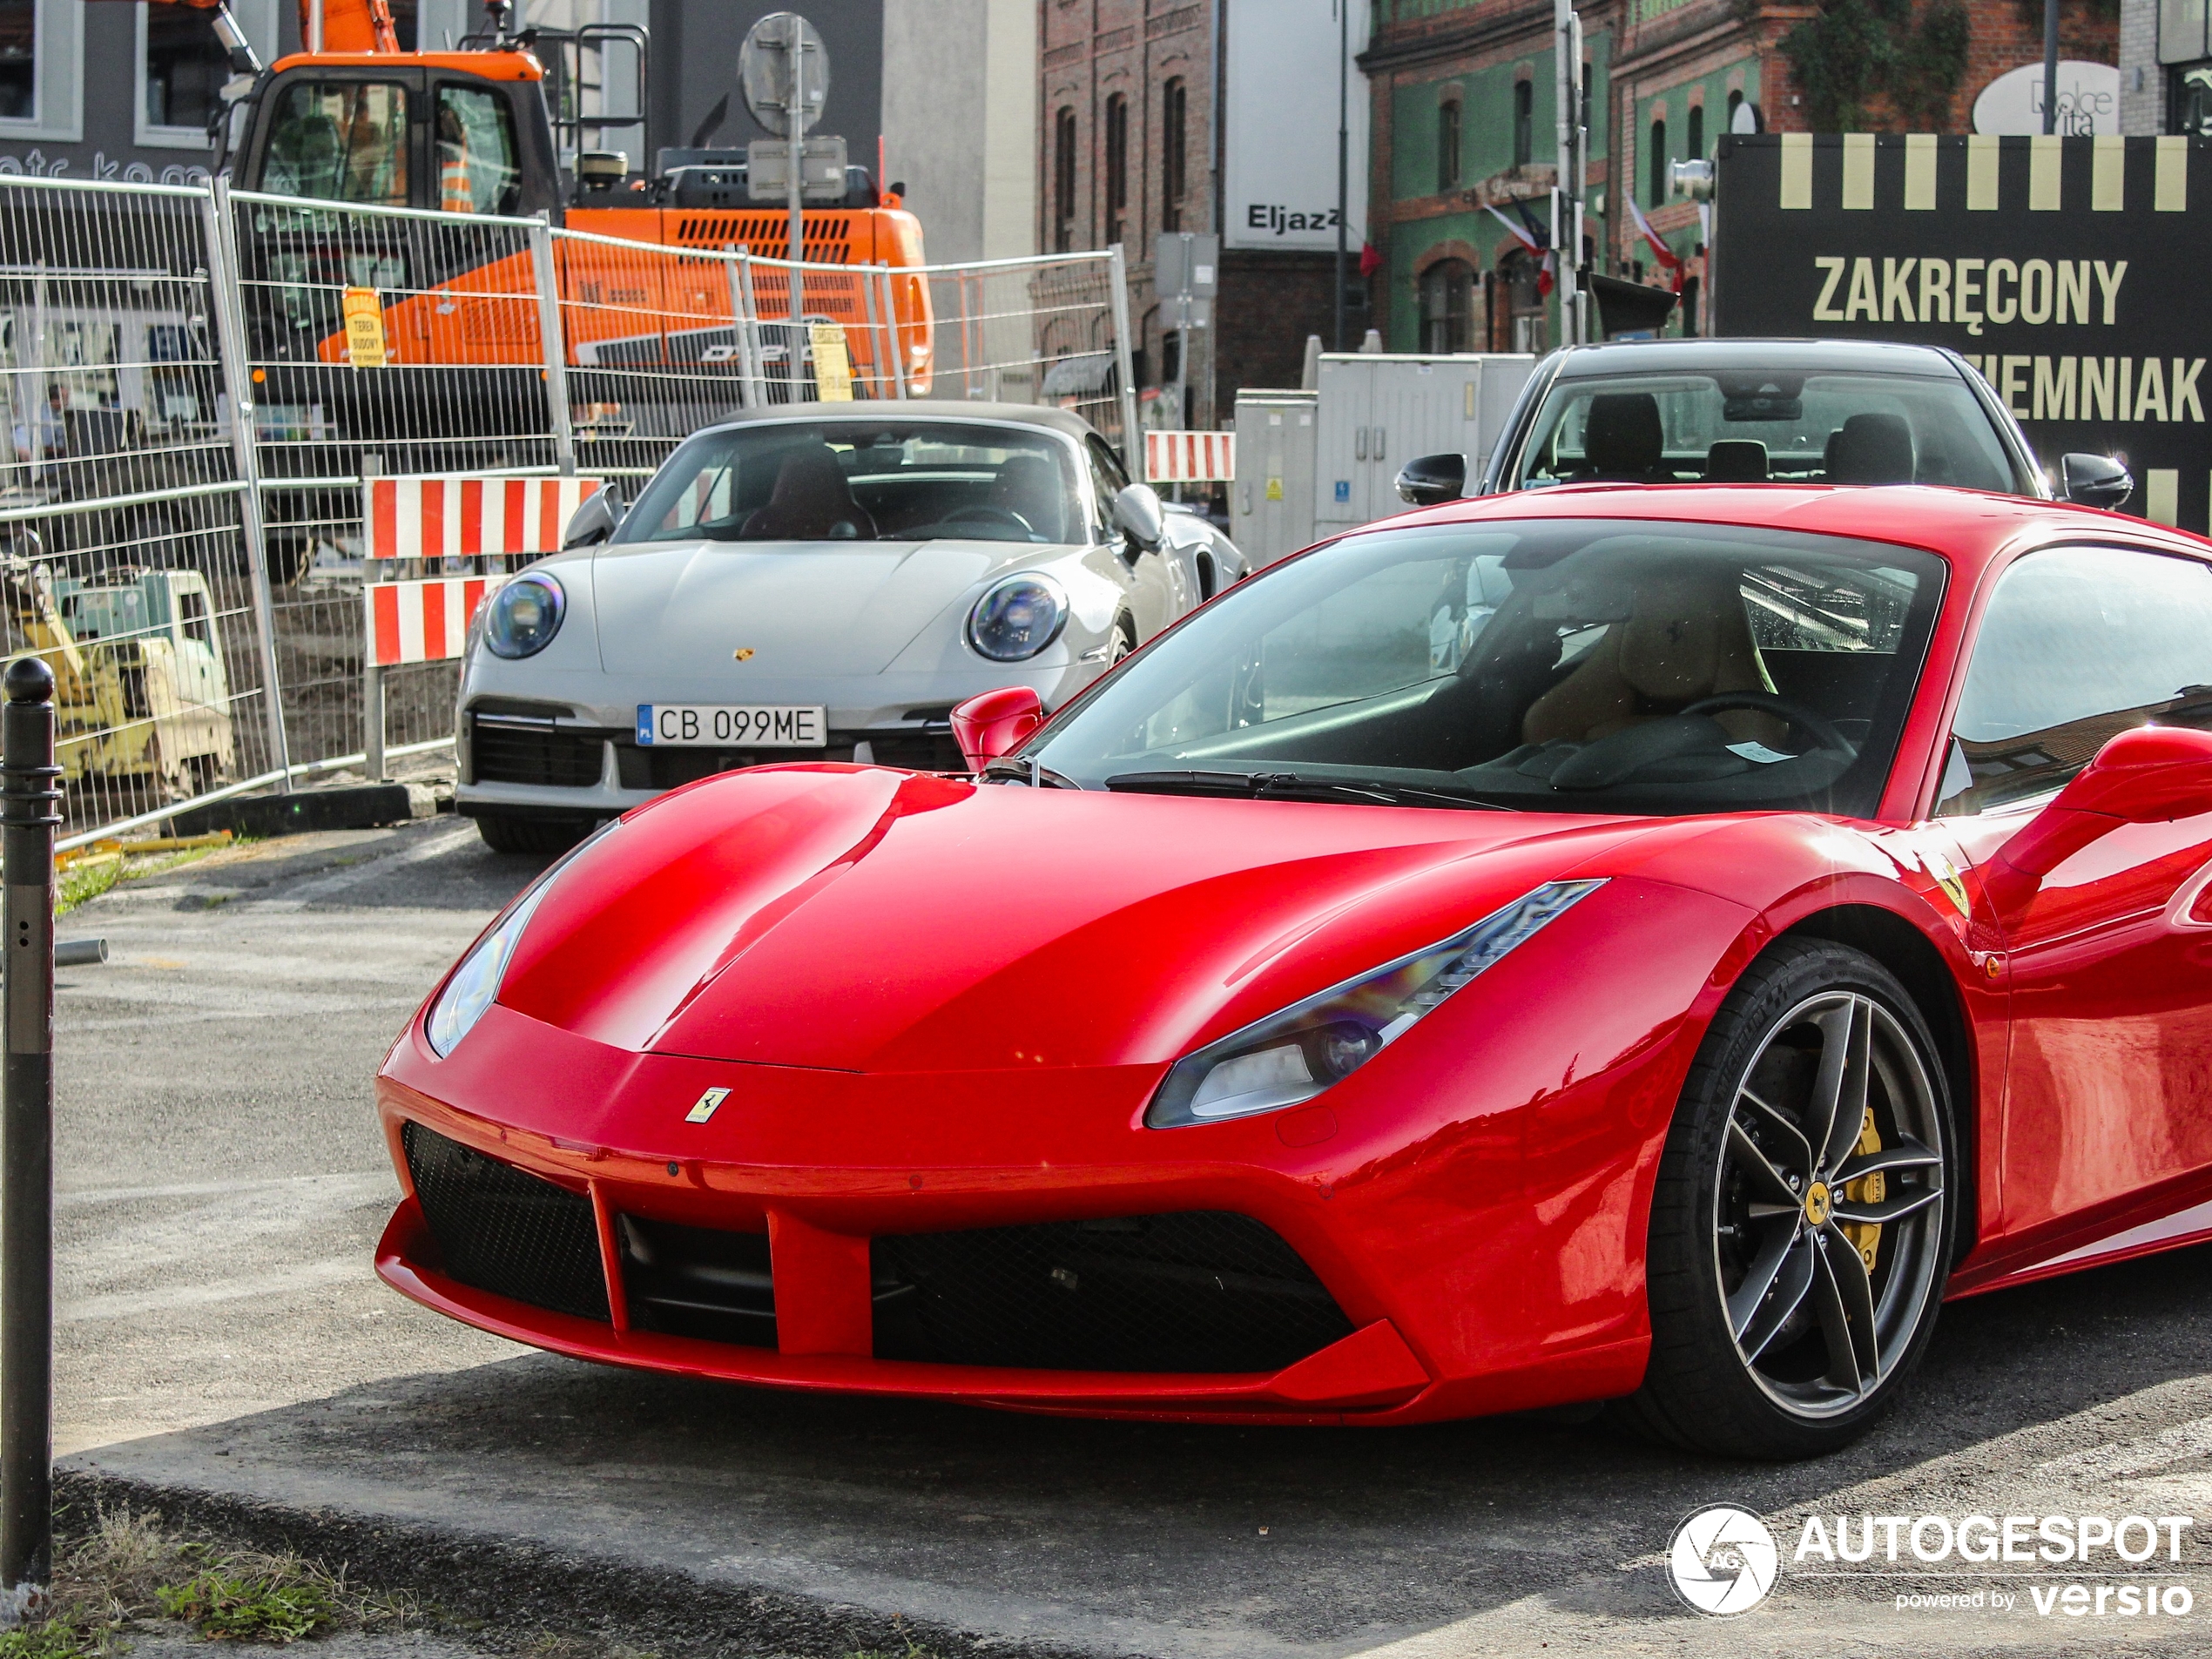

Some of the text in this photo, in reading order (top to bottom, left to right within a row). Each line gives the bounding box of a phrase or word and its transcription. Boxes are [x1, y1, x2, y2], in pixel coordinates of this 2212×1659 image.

[1813, 257, 2128, 335] ZAKRĘCONY
[639, 730, 651, 738] PL
[661, 711, 813, 740] CB 099ME
